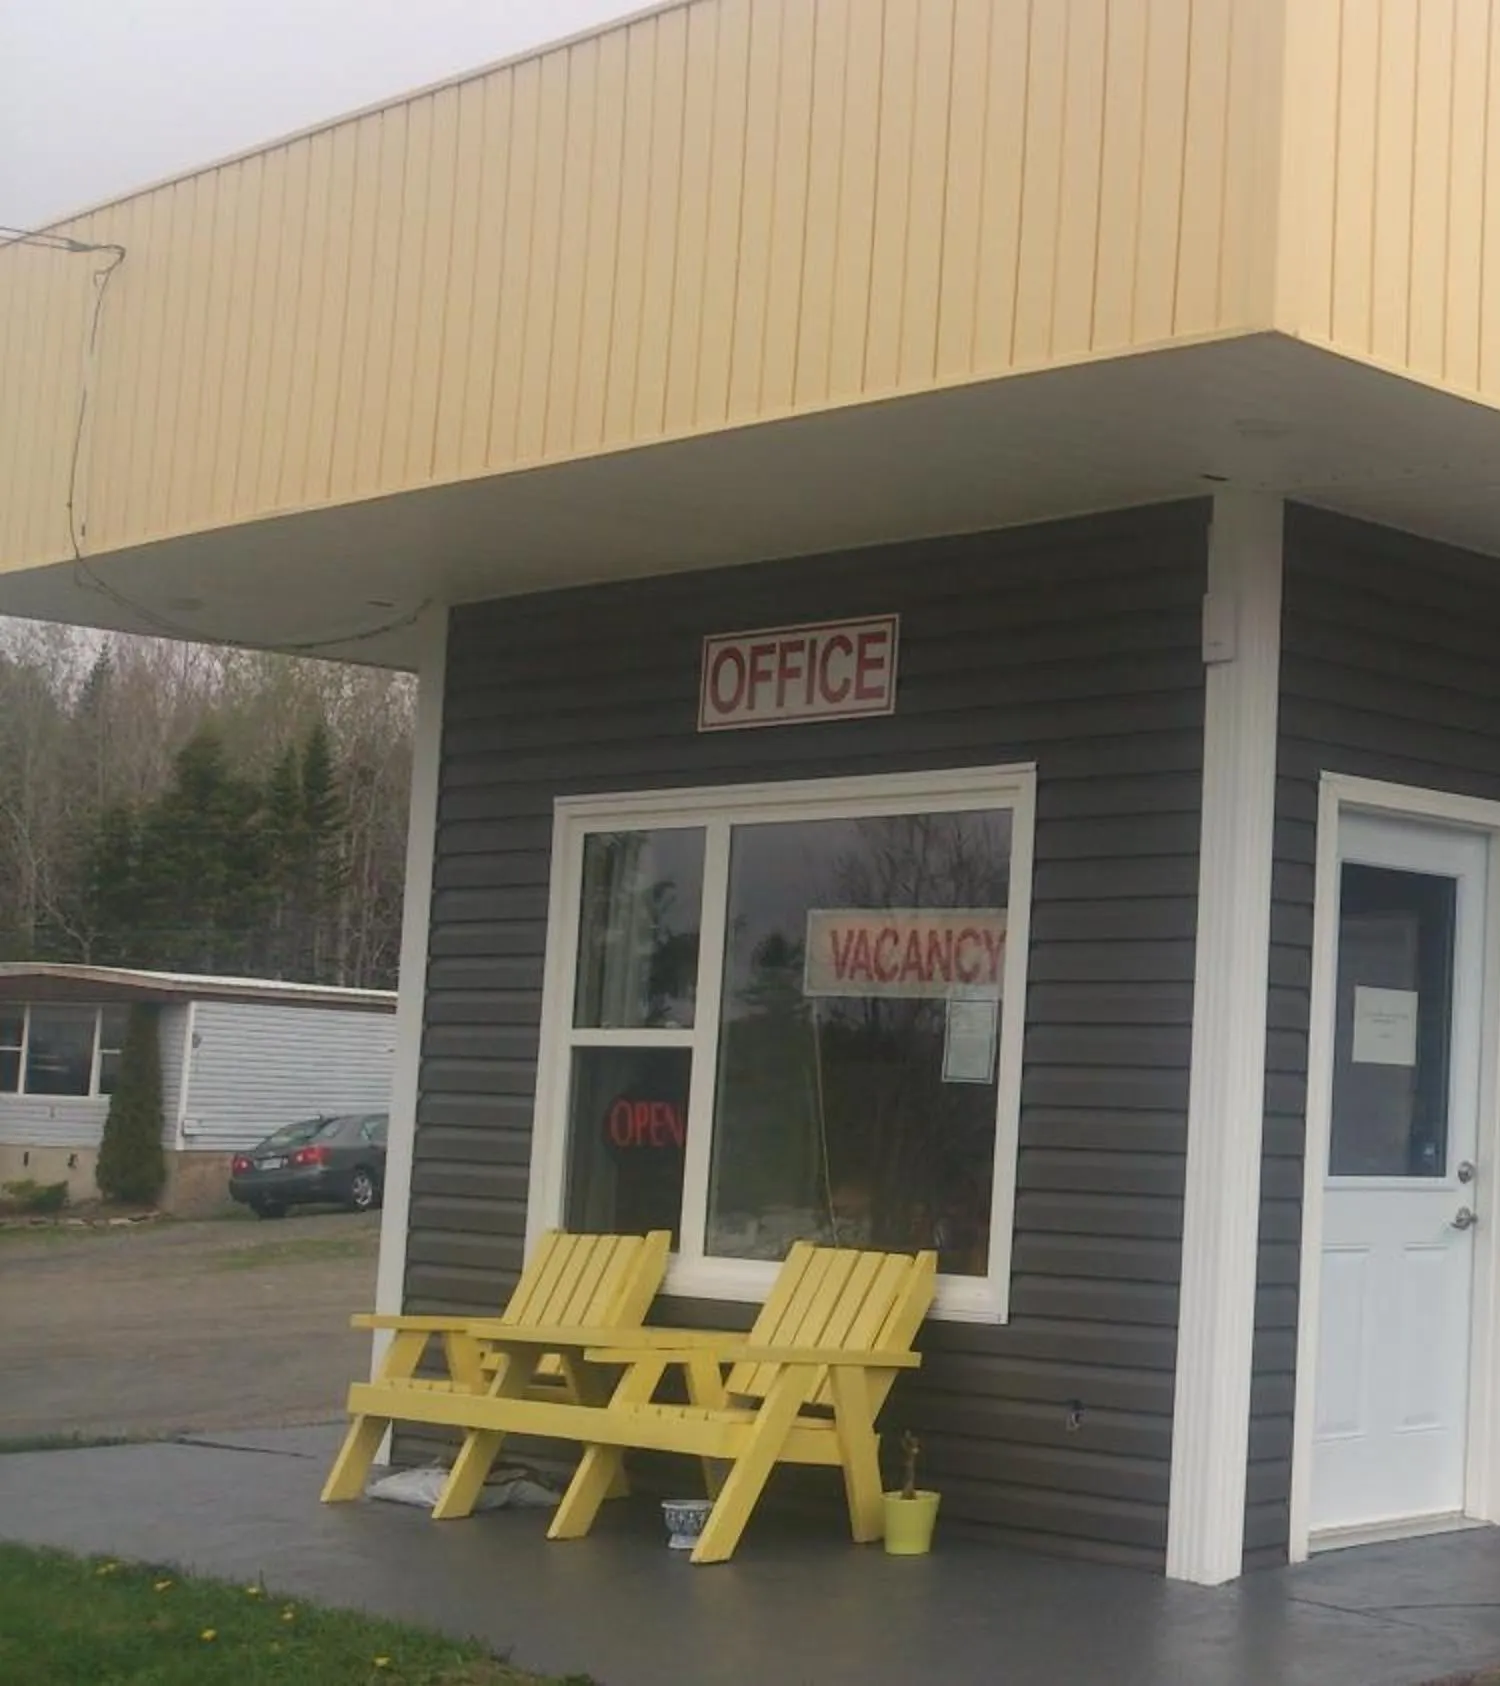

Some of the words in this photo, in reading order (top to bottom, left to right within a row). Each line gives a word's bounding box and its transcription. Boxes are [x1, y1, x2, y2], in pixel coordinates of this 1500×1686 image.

[710, 631, 887, 714] OFFICE
[829, 927, 1007, 983] VACANCY
[609, 1098, 685, 1147] OPEN
